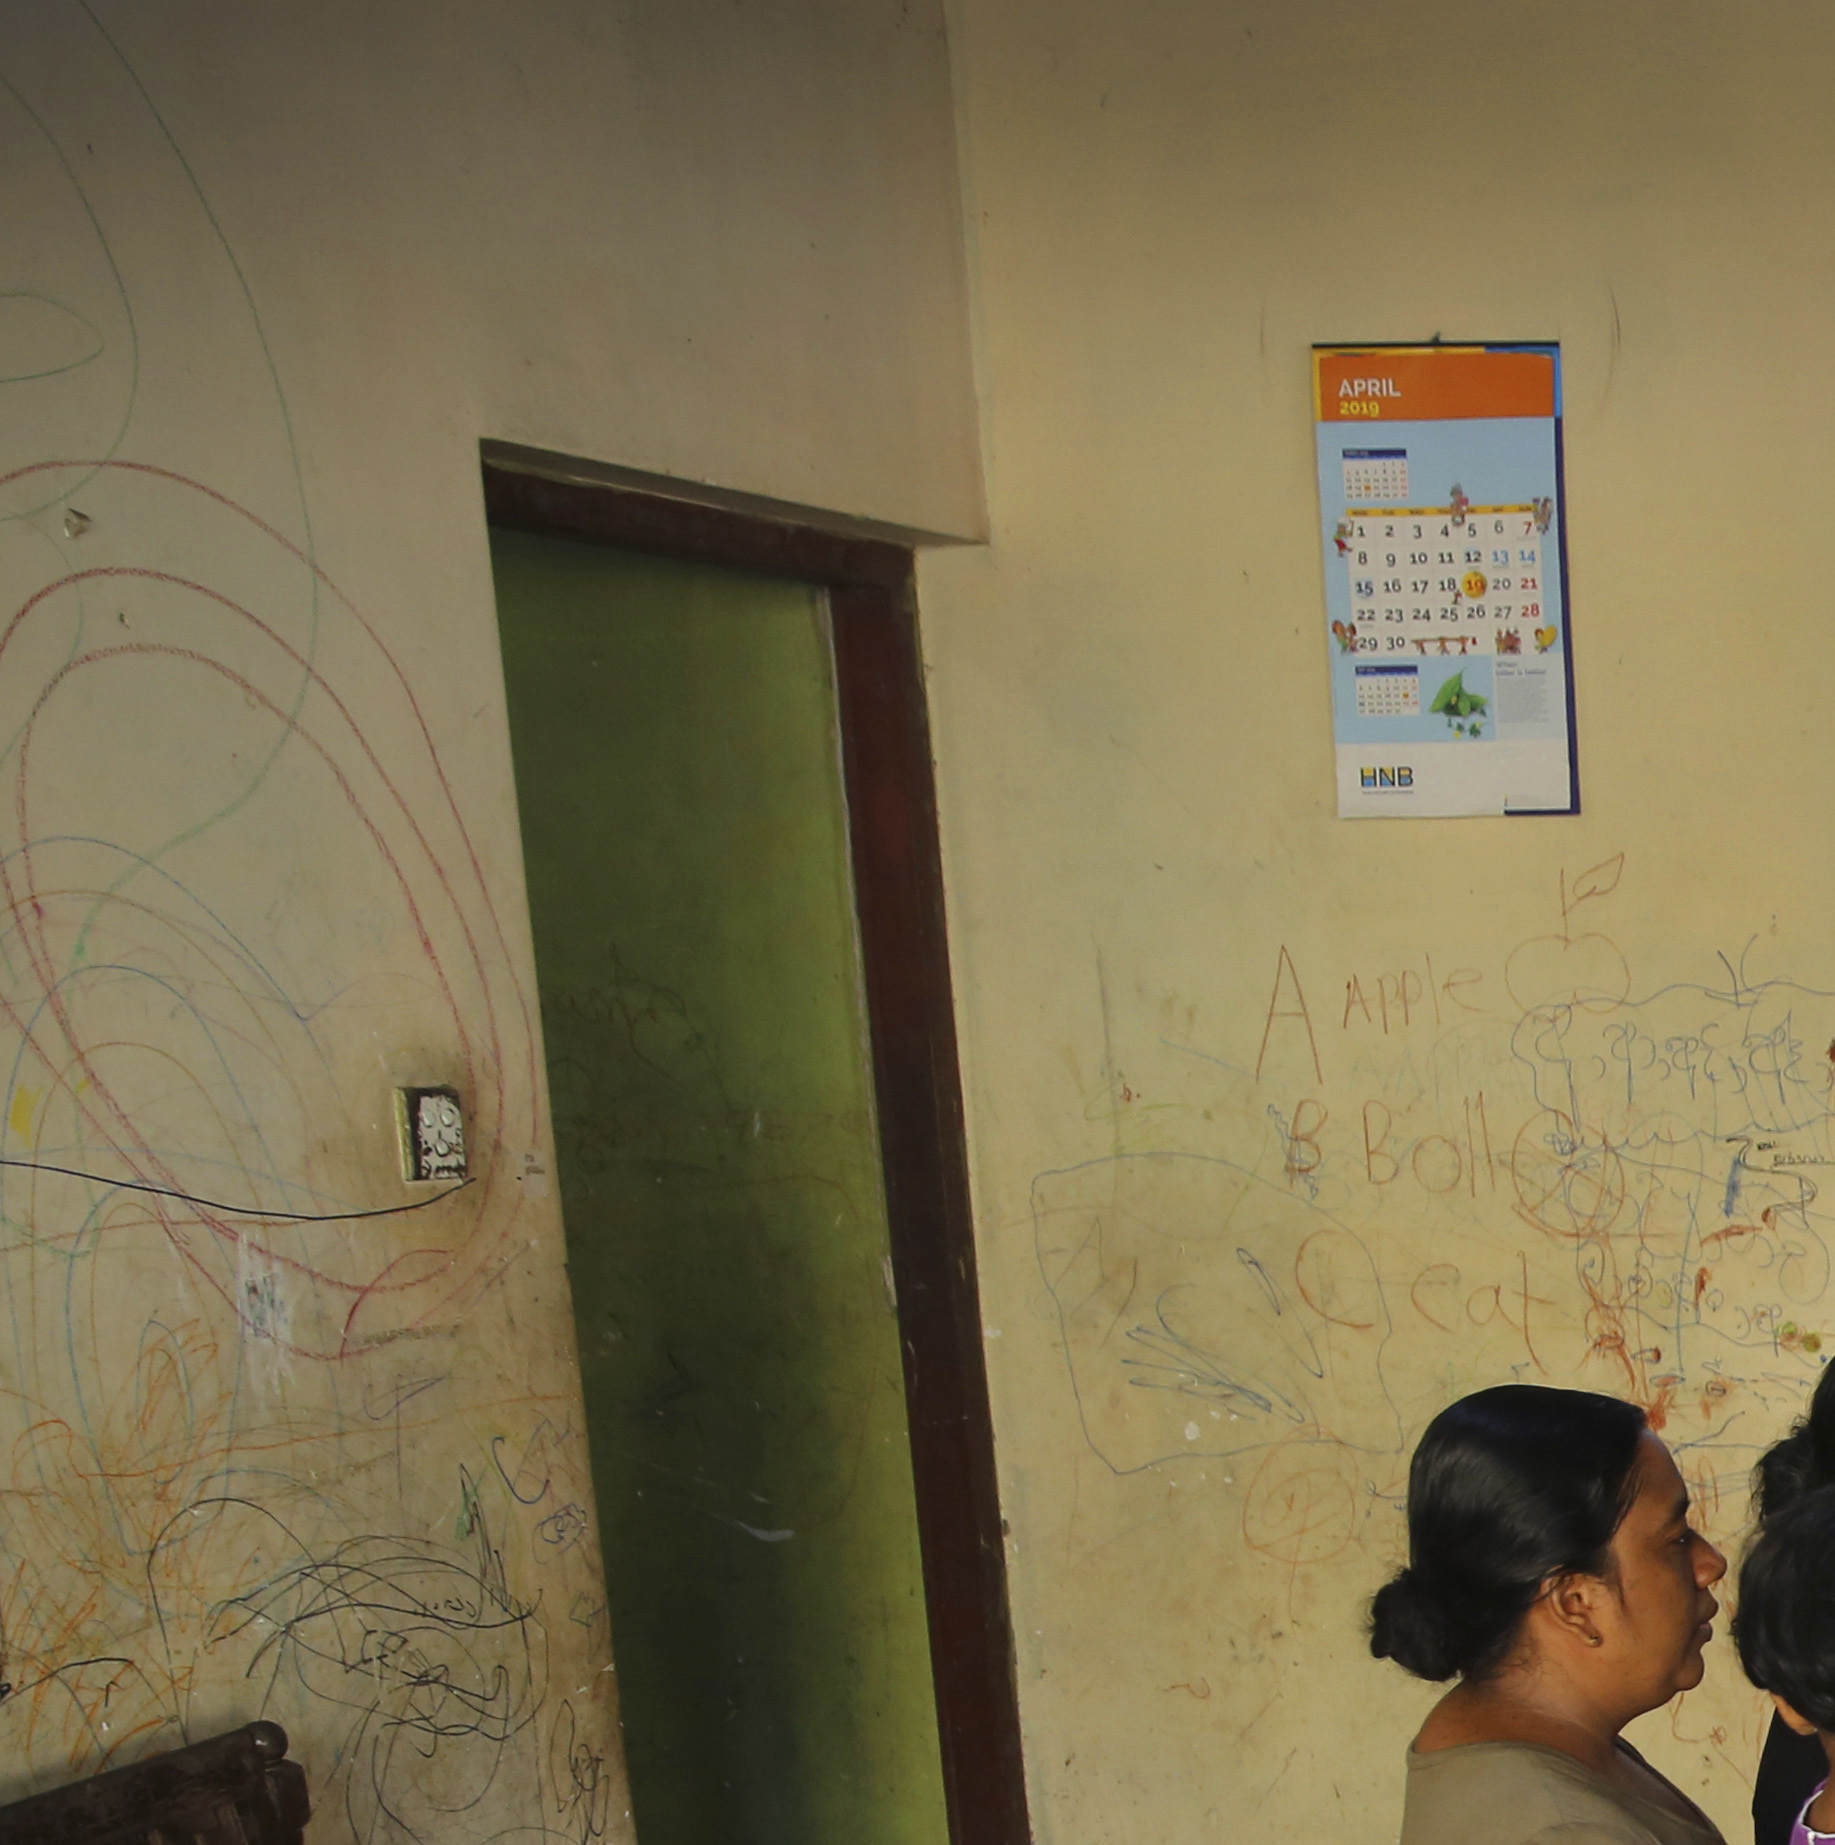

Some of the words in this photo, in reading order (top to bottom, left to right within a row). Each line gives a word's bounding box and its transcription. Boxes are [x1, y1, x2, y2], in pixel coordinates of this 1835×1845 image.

[1339, 378, 1402, 397] APRIL
[1340, 401, 1380, 417] 2019
[1357, 525, 1365, 537] 1
[1385, 524, 1394, 537] 2
[1413, 524, 1422, 539] 3
[1440, 524, 1449, 537] 4
[1468, 523, 1476, 537] 5
[1494, 520, 1503, 534] 6
[1524, 521, 1532, 535] 7
[1358, 551, 1367, 565] 8
[1386, 553, 1396, 567] 9
[1410, 552, 1428, 564] 10
[1439, 552, 1454, 564] 11
[1465, 551, 1481, 563] 12
[1492, 550, 1509, 565] 13
[1519, 549, 1536, 562] 14
[1356, 580, 1373, 597] 15
[1384, 578, 1401, 593] 16
[1412, 580, 1428, 594] 17
[1439, 577, 1456, 591] 18
[1466, 579, 1485, 593] 19
[1493, 578, 1511, 590] 20
[1520, 577, 1538, 590] 21
[1357, 609, 1375, 621] 22
[1385, 609, 1403, 622] 23
[1412, 608, 1430, 621] 24
[1440, 607, 1458, 621] 25
[1467, 604, 1485, 618] 26
[1494, 605, 1512, 619] 27
[1521, 603, 1539, 617] 28
[1359, 637, 1378, 651] 29
[1387, 636, 1405, 651] 30
[1360, 766, 1414, 787] HNB
[1256, 944, 1323, 1085] A
[1286, 1098, 1328, 1188] B
[1295, 1229, 1374, 1329] C
